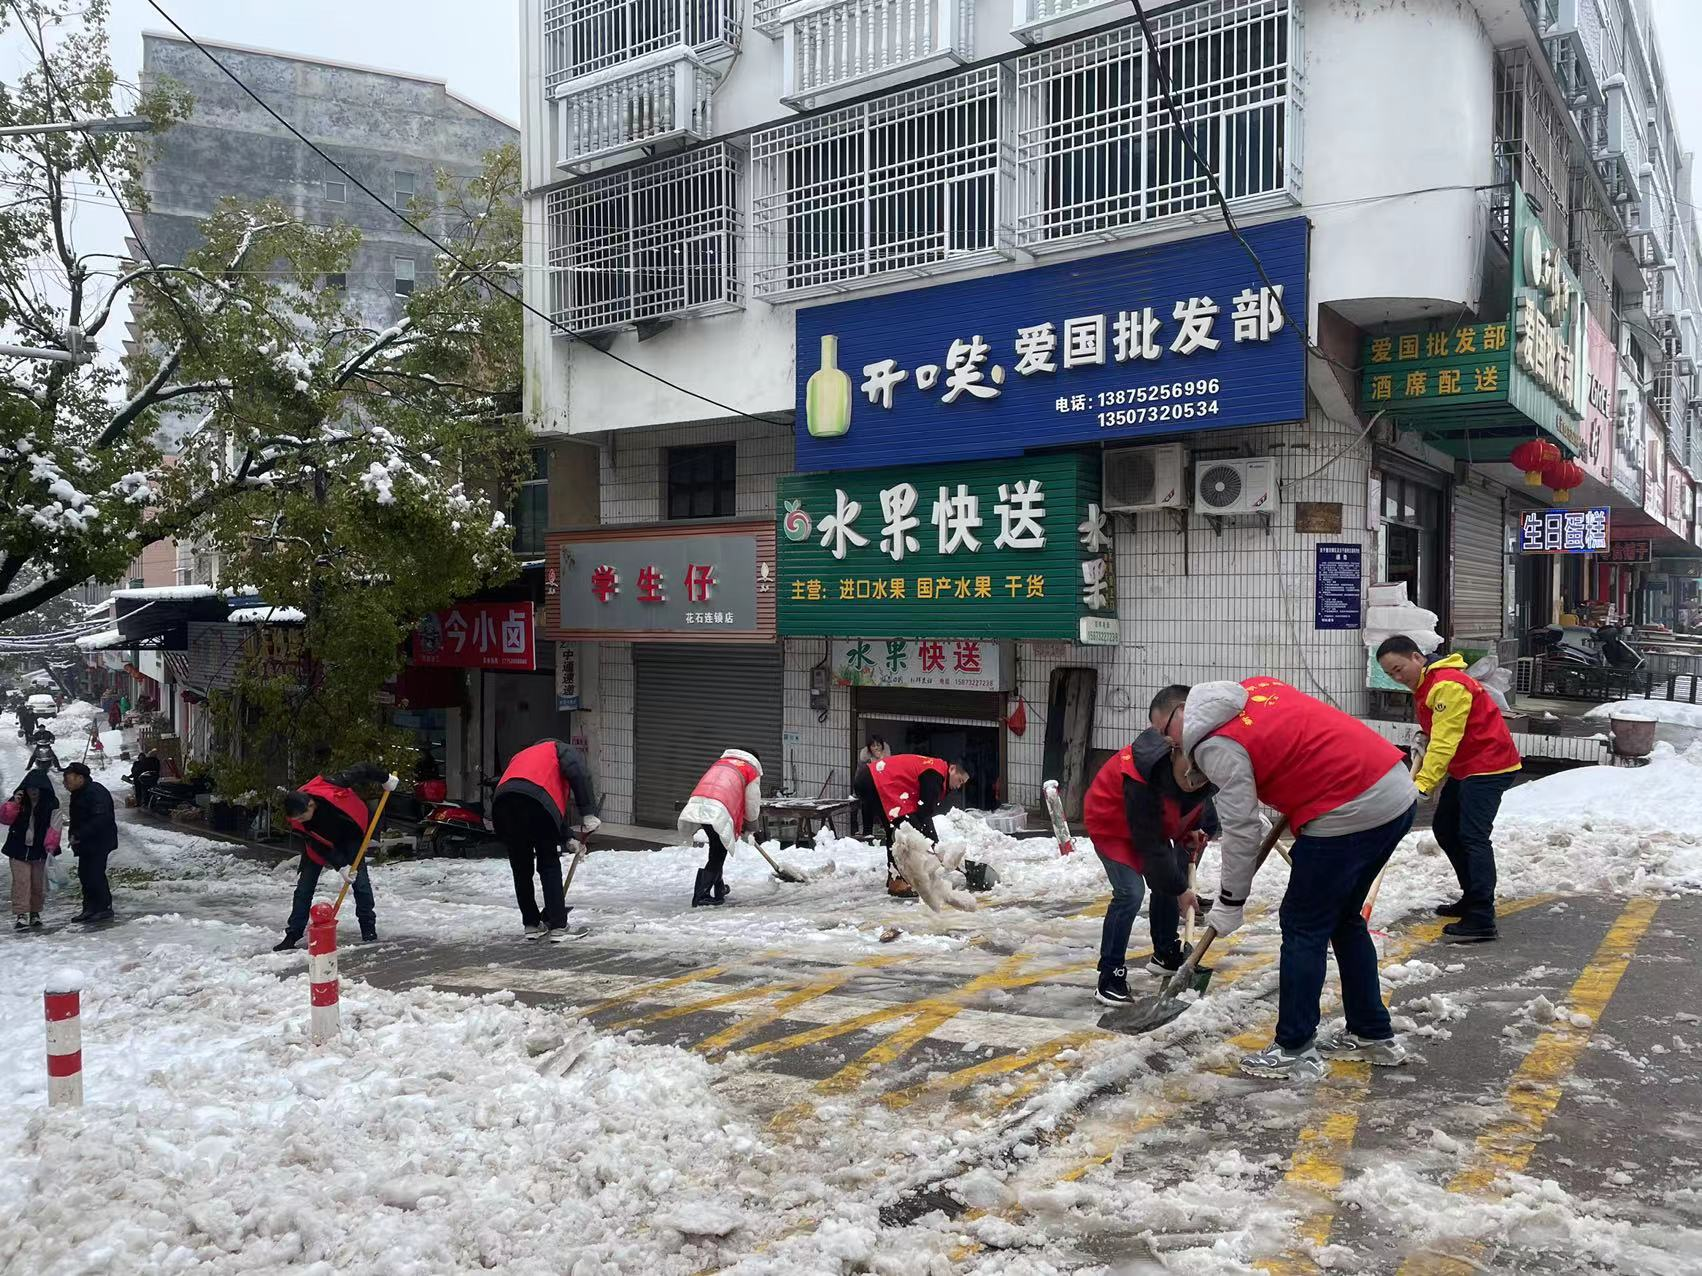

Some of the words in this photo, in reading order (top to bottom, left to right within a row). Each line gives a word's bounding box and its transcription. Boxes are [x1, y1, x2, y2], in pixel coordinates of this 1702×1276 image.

[1013, 284, 1286, 377] 爱国批发部
[1370, 324, 1506, 364] 爱国批发部
[1371, 366, 1498, 401] 酒席配送
[1097, 400, 1219, 428] 13507320534
[817, 479, 1048, 561] 水果快送
[1523, 510, 1606, 550] 生日蛋糕
[592, 562, 718, 603] 学生仔
[839, 578, 907, 600] 进口水果
[916, 575, 992, 600] 国产水果
[1005, 574, 1045, 599] 干货
[445, 609, 526, 654] 今小卤
[685, 612, 734, 624] 花石连锁店
[847, 638, 983, 674] 水果快送
